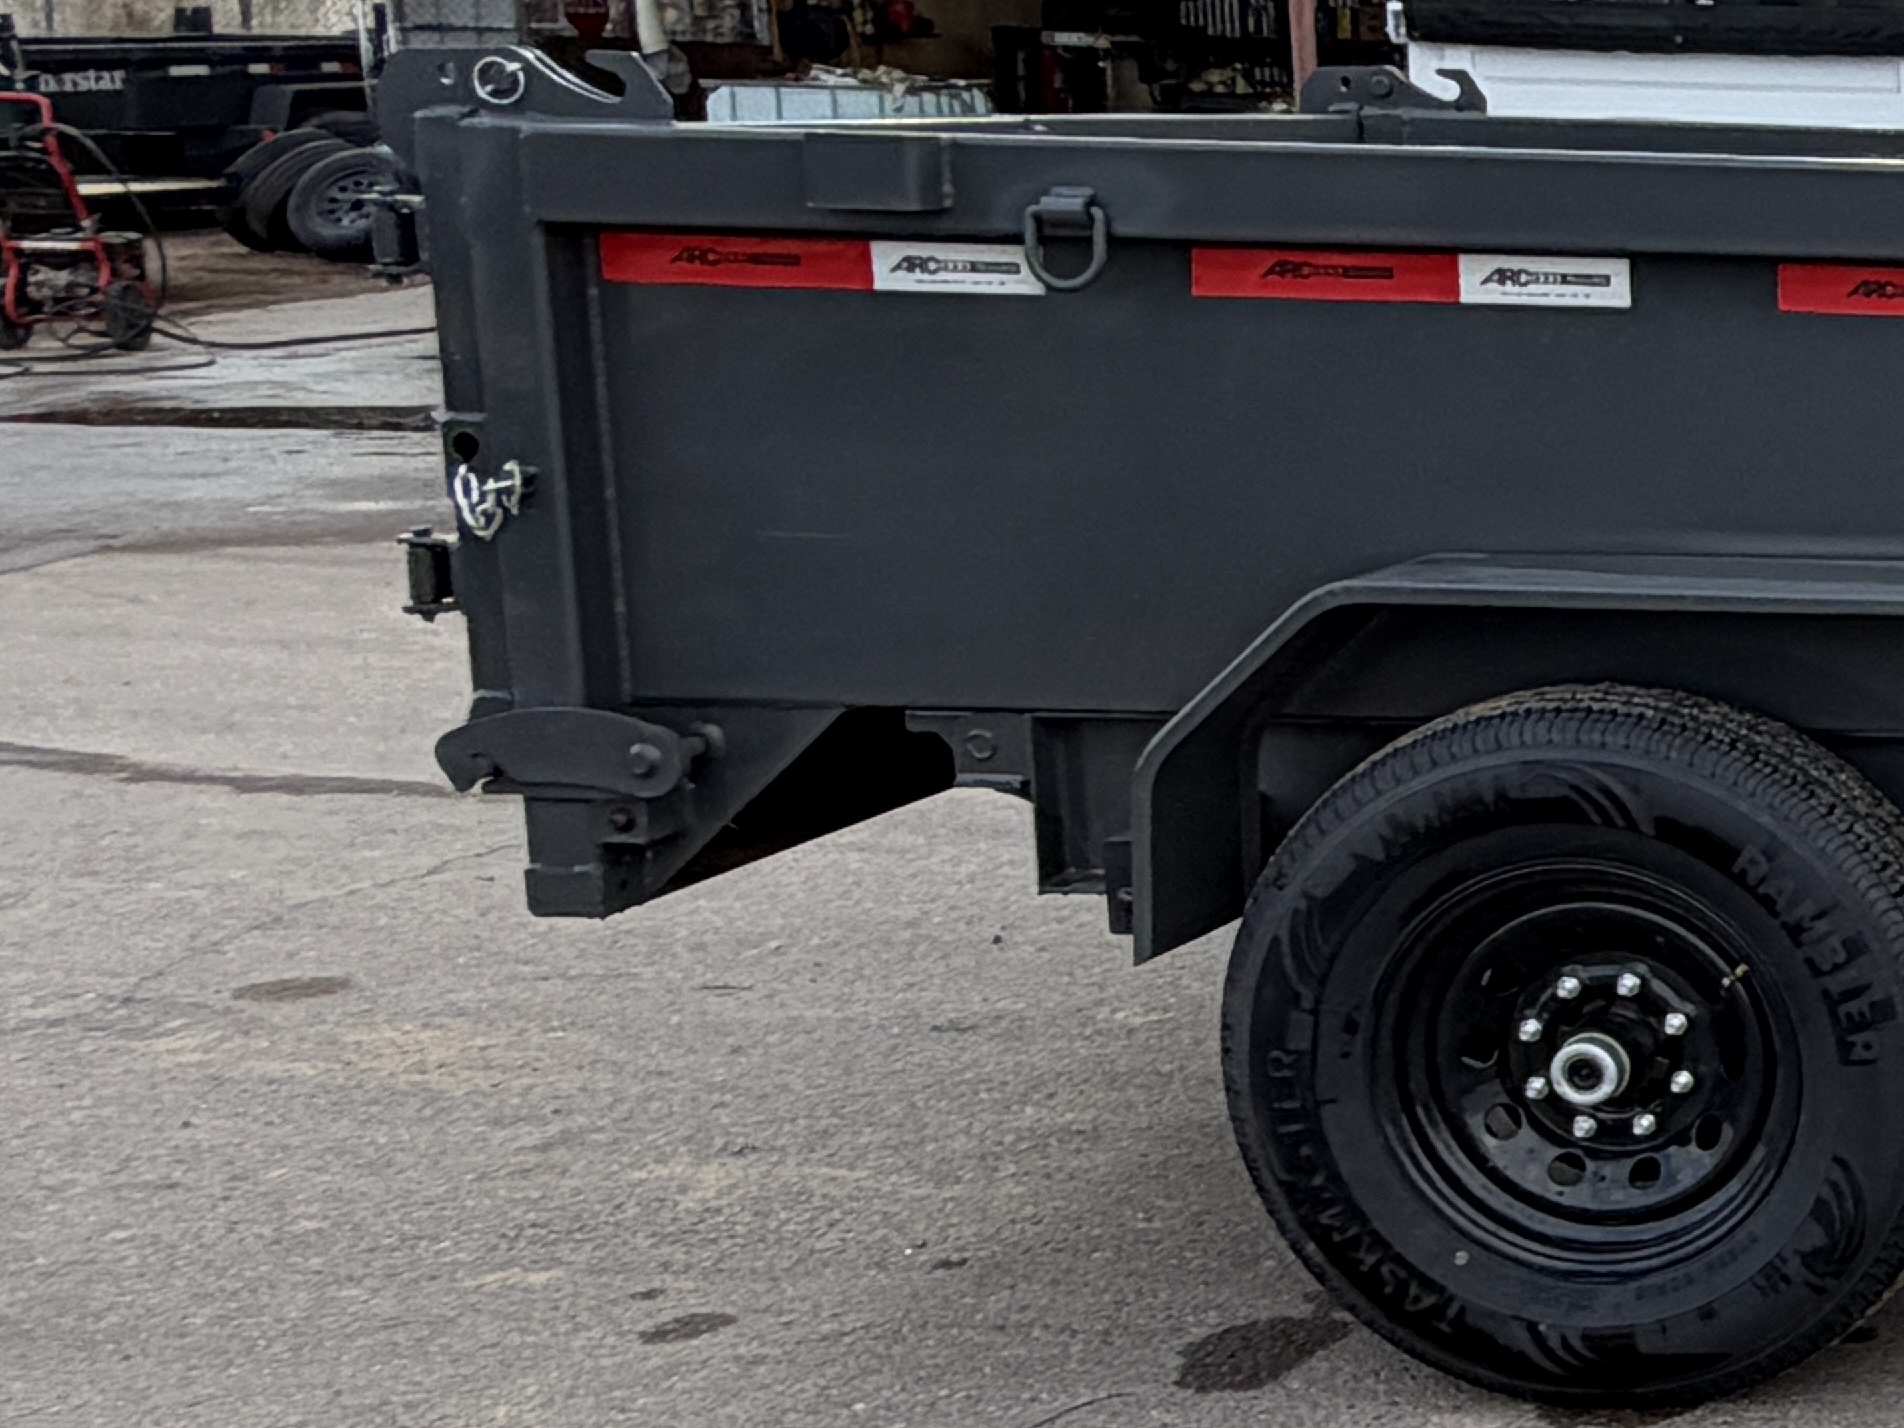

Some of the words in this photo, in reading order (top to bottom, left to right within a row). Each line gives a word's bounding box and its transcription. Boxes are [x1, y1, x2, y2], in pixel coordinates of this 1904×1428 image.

[39, 69, 126, 92] nrstar
[670, 247, 721, 266] ARC
[889, 255, 941, 275] ARC
[1261, 259, 1311, 280] ARC
[1479, 267, 1529, 287] ARC
[1846, 279, 1896, 299] ARC
[1732, 842, 1882, 1064] RAMBLER
